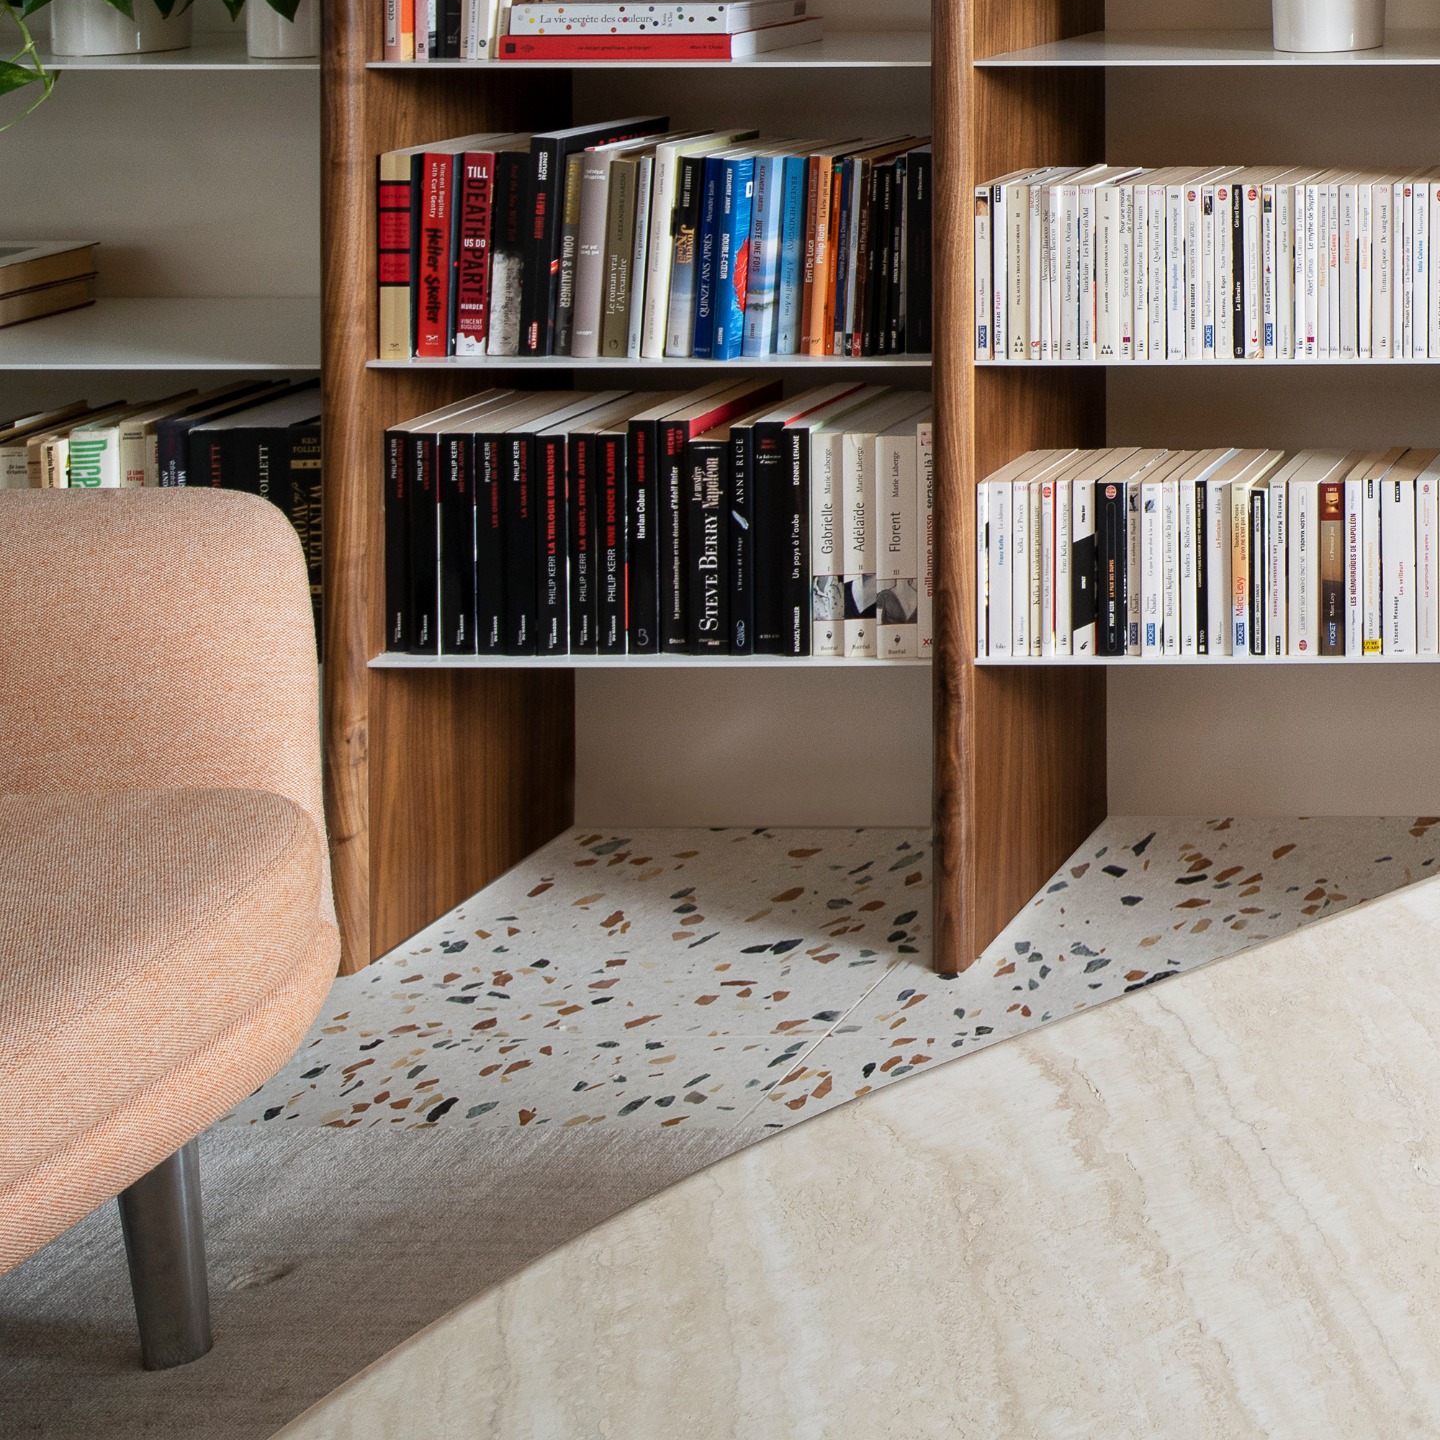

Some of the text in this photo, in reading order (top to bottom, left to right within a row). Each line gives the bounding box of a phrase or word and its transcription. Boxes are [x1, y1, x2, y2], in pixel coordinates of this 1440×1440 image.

[540, 15, 551, 23] La
[554, 15, 566, 23] vie
[569, 15, 598, 23] secrète
[601, 15, 615, 23] des
[468, 166, 488, 178] TILL
[463, 179, 488, 238] DEATH
[464, 239, 474, 247] US
[563, 236, 574, 258] OONA
[675, 234, 687, 264] Noël
[680, 224, 695, 264] Joyeux
[787, 206, 796, 252] HEMINGWAY
[816, 223, 825, 264] Philip Roth
[424, 228, 444, 324] Helter Skelter
[463, 248, 485, 296] PART
[700, 234, 712, 317] QUINZE ANS APRÈS
[720, 233, 730, 280] DOUBLE-CŒUR
[753, 256, 761, 272] FOIS
[807, 258, 813, 268] De
[559, 269, 572, 308] SALINGER
[607, 255, 618, 314] Le roman vrai
[617, 259, 627, 311] d'Alexandre
[547, 444, 555, 497] BERLINOISE
[824, 448, 832, 474] Laberge
[578, 479, 586, 507] ENTRE
[692, 466, 702, 501] Le mystère
[702, 458, 723, 509] Napoléon
[547, 499, 555, 540] TRILOGIE
[607, 442, 616, 602] PHILIP KERR UNE DOUCE FLAMME
[637, 489, 645, 539] Harlan Coben
[791, 514, 799, 538] l'aube
[821, 503, 833, 554] Gabrielle
[853, 502, 865, 552] Adélaïde
[889, 512, 900, 552] Florent
[548, 542, 555, 554] LA
[579, 539, 586, 550] LA
[792, 548, 801, 564] pays
[698, 514, 719, 630] STEVE BERRY
[792, 568, 800, 579] Un
[1236, 576, 1245, 616] Marc Levy
[1236, 623, 1244, 645] POCKET
